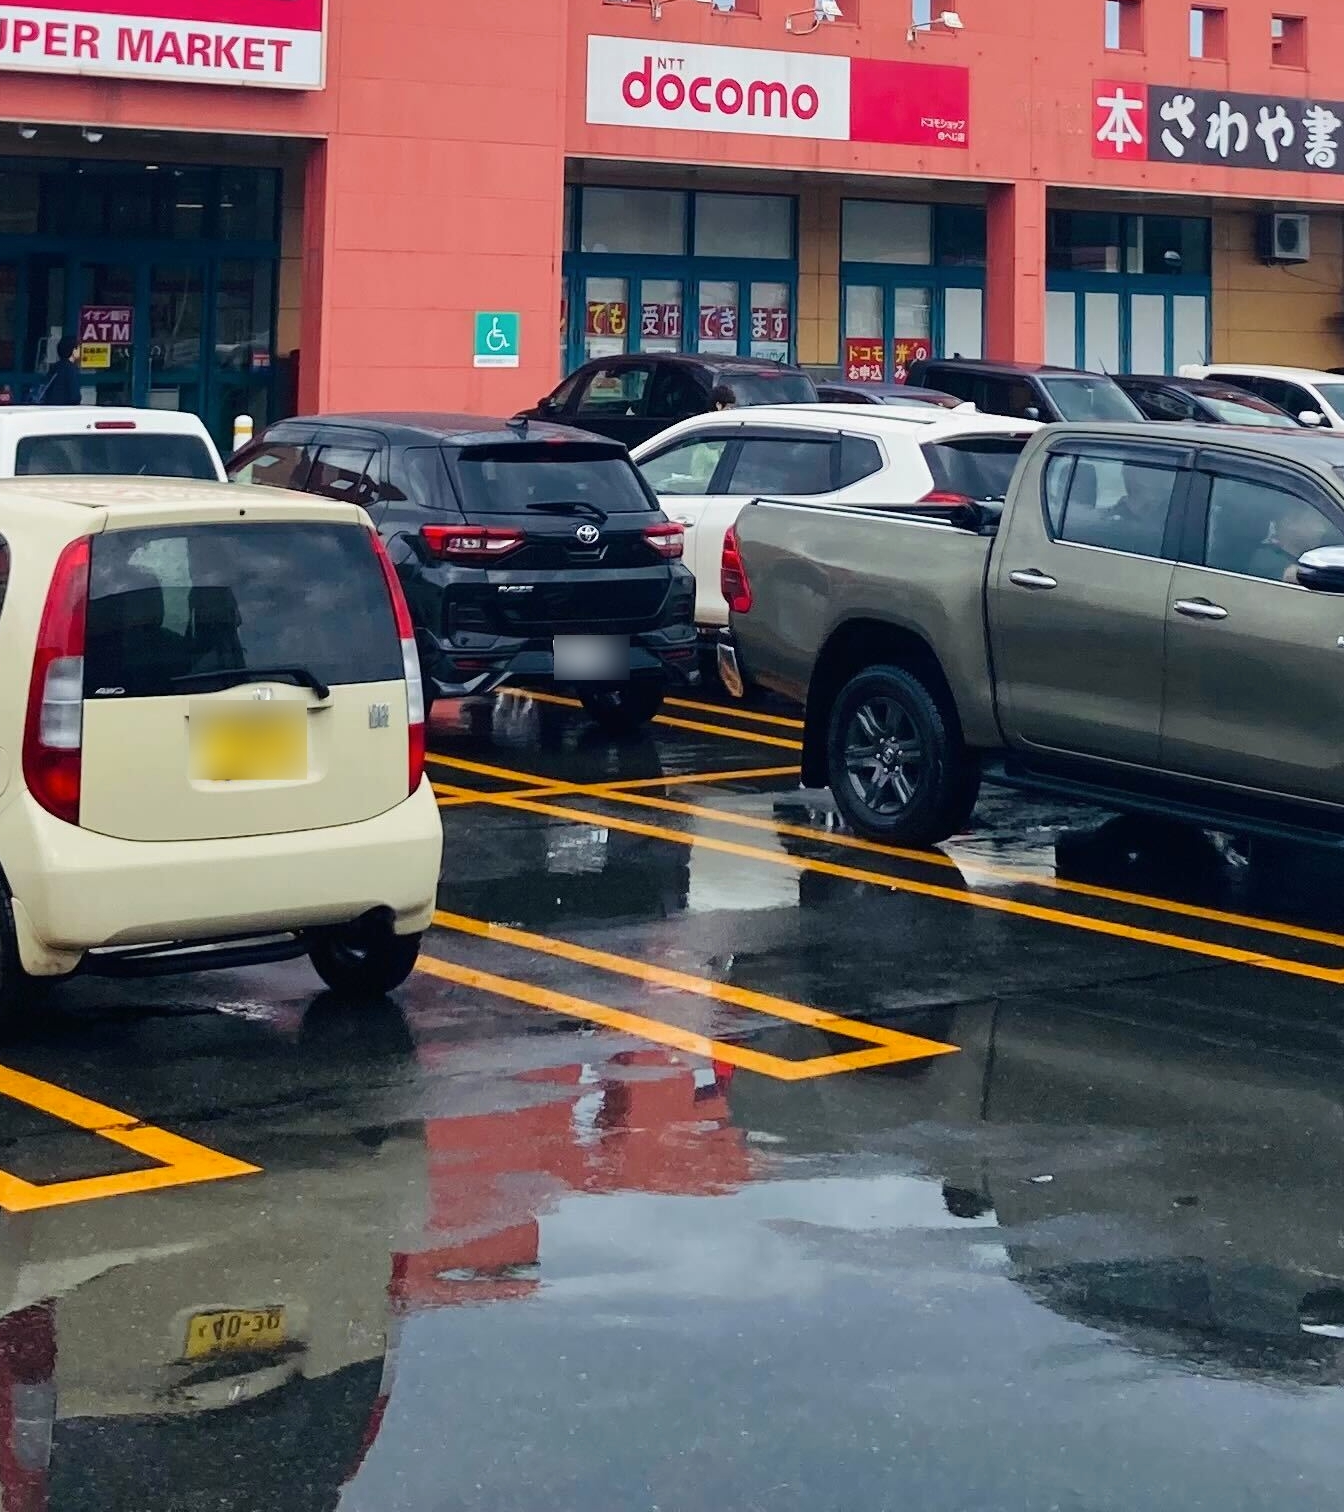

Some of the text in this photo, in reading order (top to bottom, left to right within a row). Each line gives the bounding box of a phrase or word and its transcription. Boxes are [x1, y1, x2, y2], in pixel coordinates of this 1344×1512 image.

[116, 27, 293, 73] MARKET
[657, 57, 685, 71] NTT
[622, 55, 819, 120] docomo
[1096, 87, 1144, 153] 本
[82, 323, 130, 341] ATM
